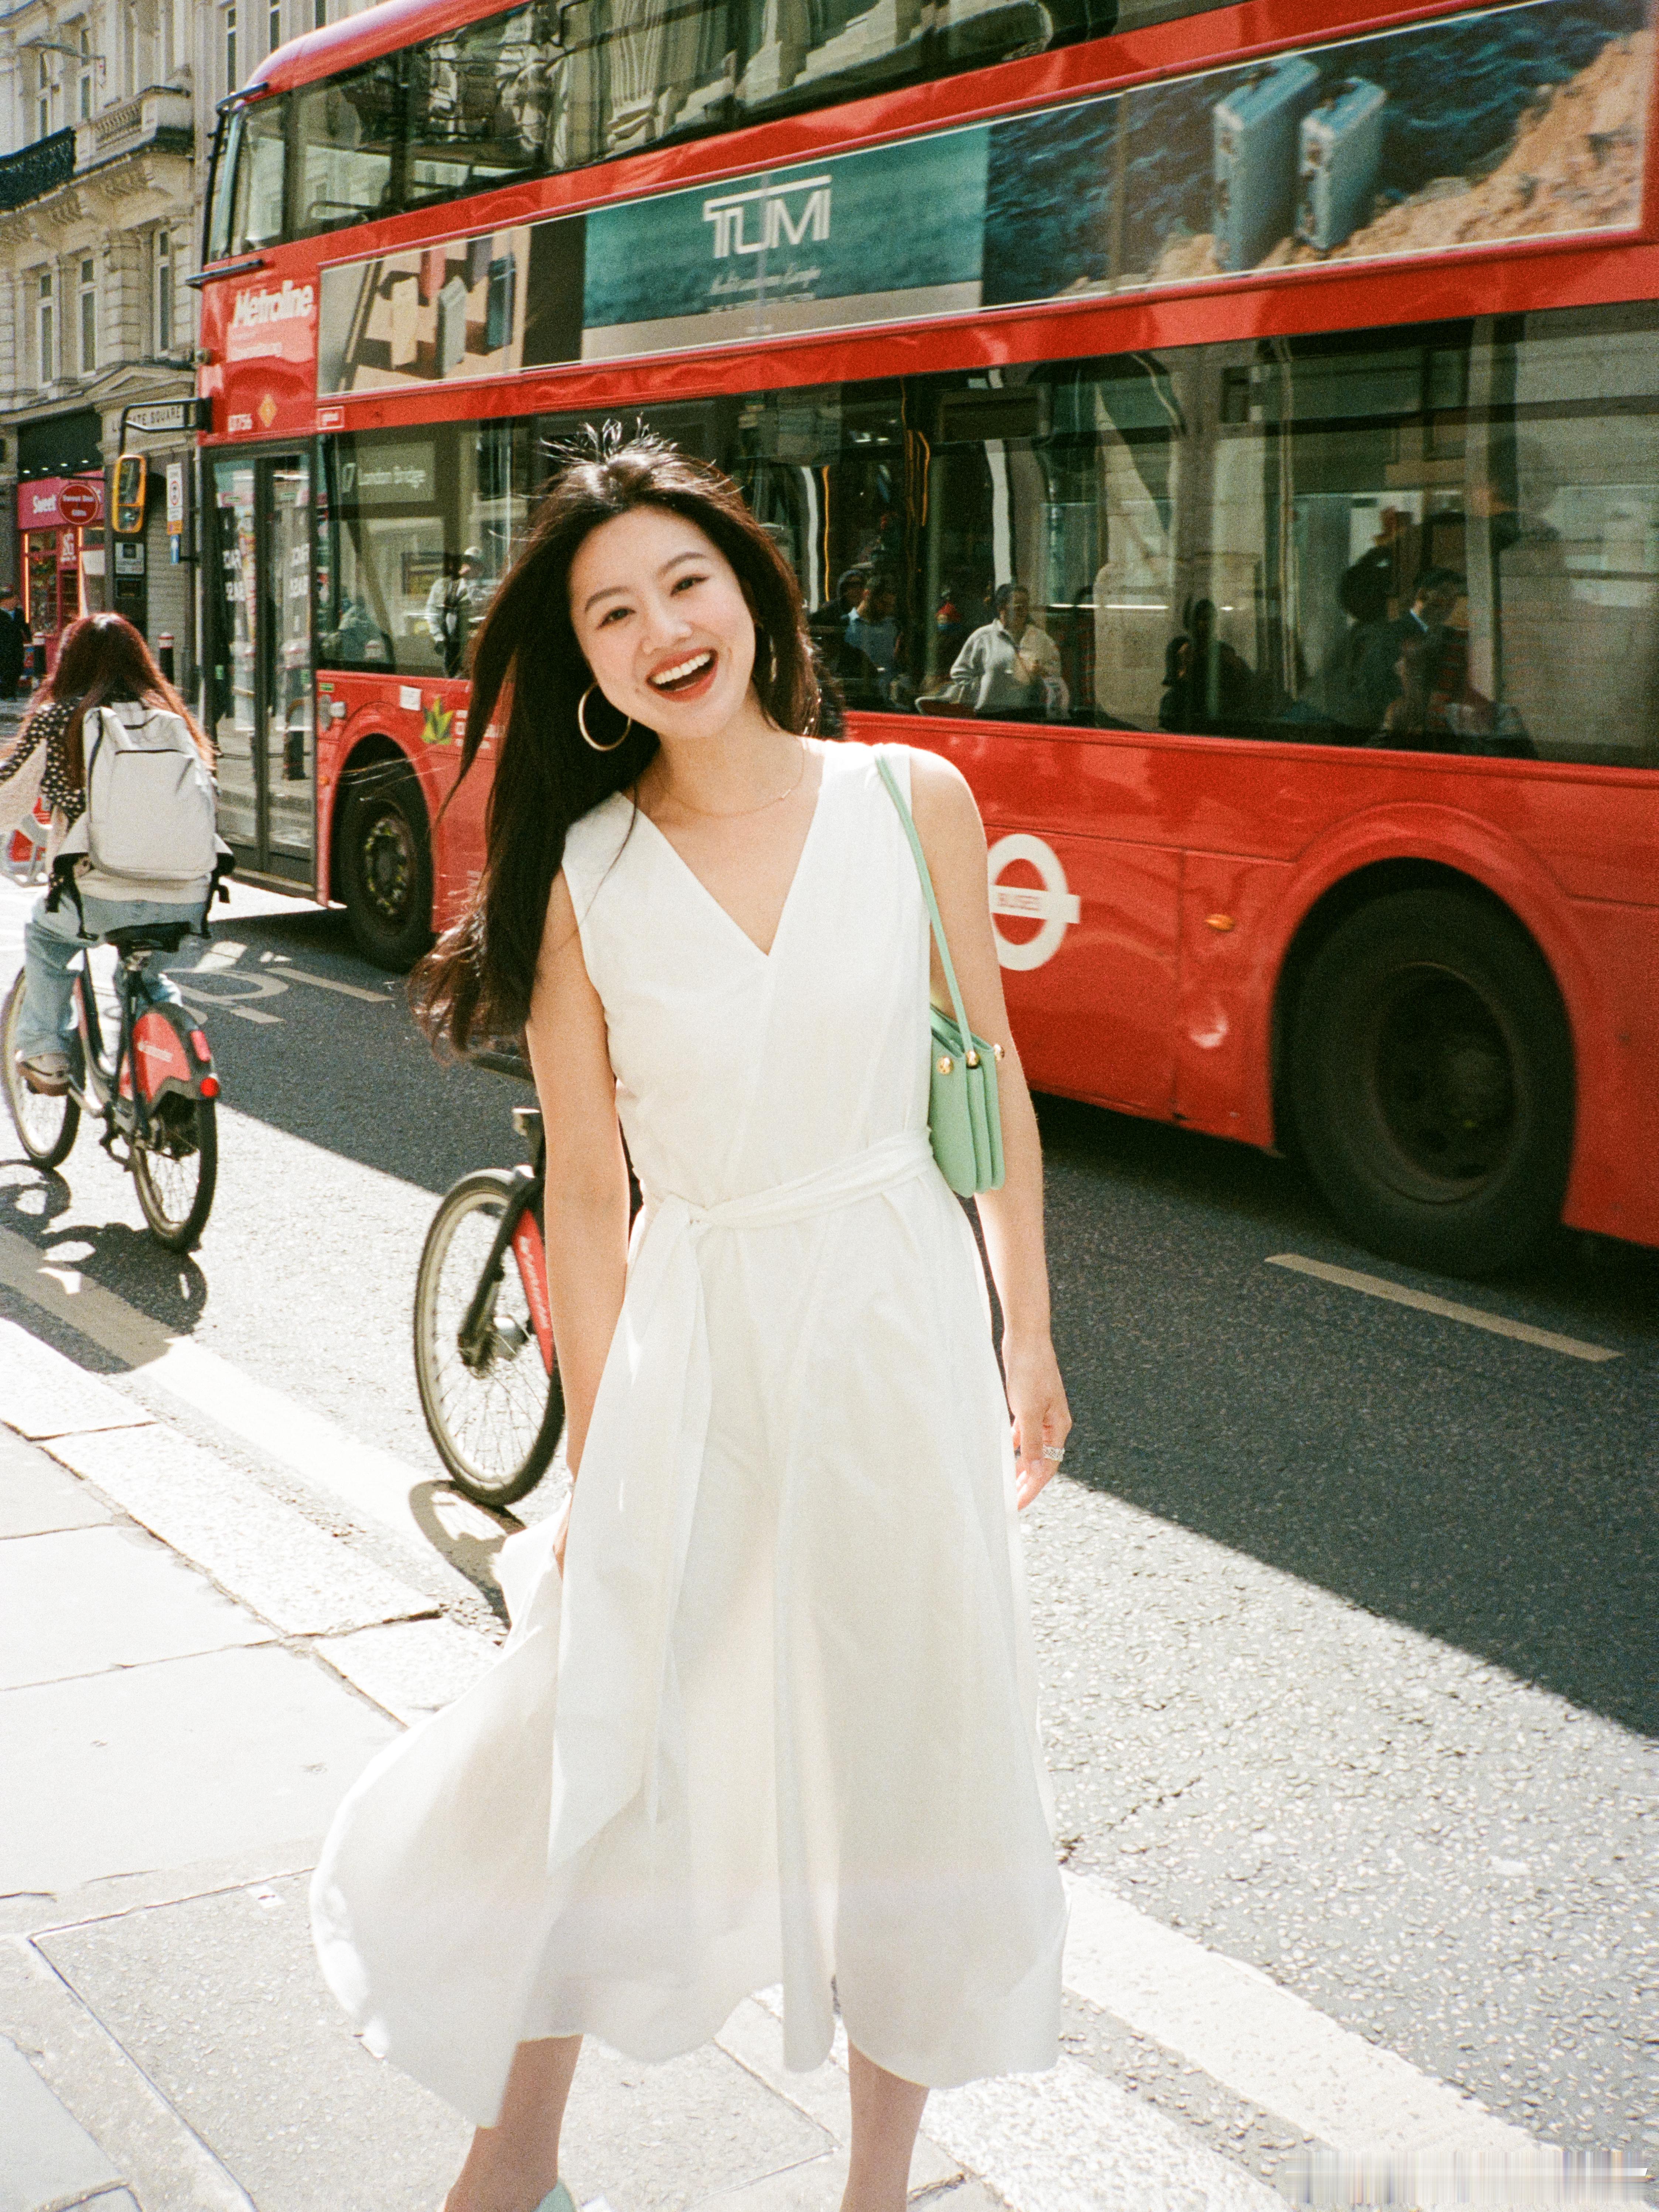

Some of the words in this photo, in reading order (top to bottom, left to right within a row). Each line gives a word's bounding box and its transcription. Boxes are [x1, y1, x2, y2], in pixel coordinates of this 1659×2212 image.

[703, 174, 832, 259] TUMI
[233, 280, 314, 327] Metroline
[150, 405, 181, 424] SQUARE
[33, 494, 57, 514] Sweet
